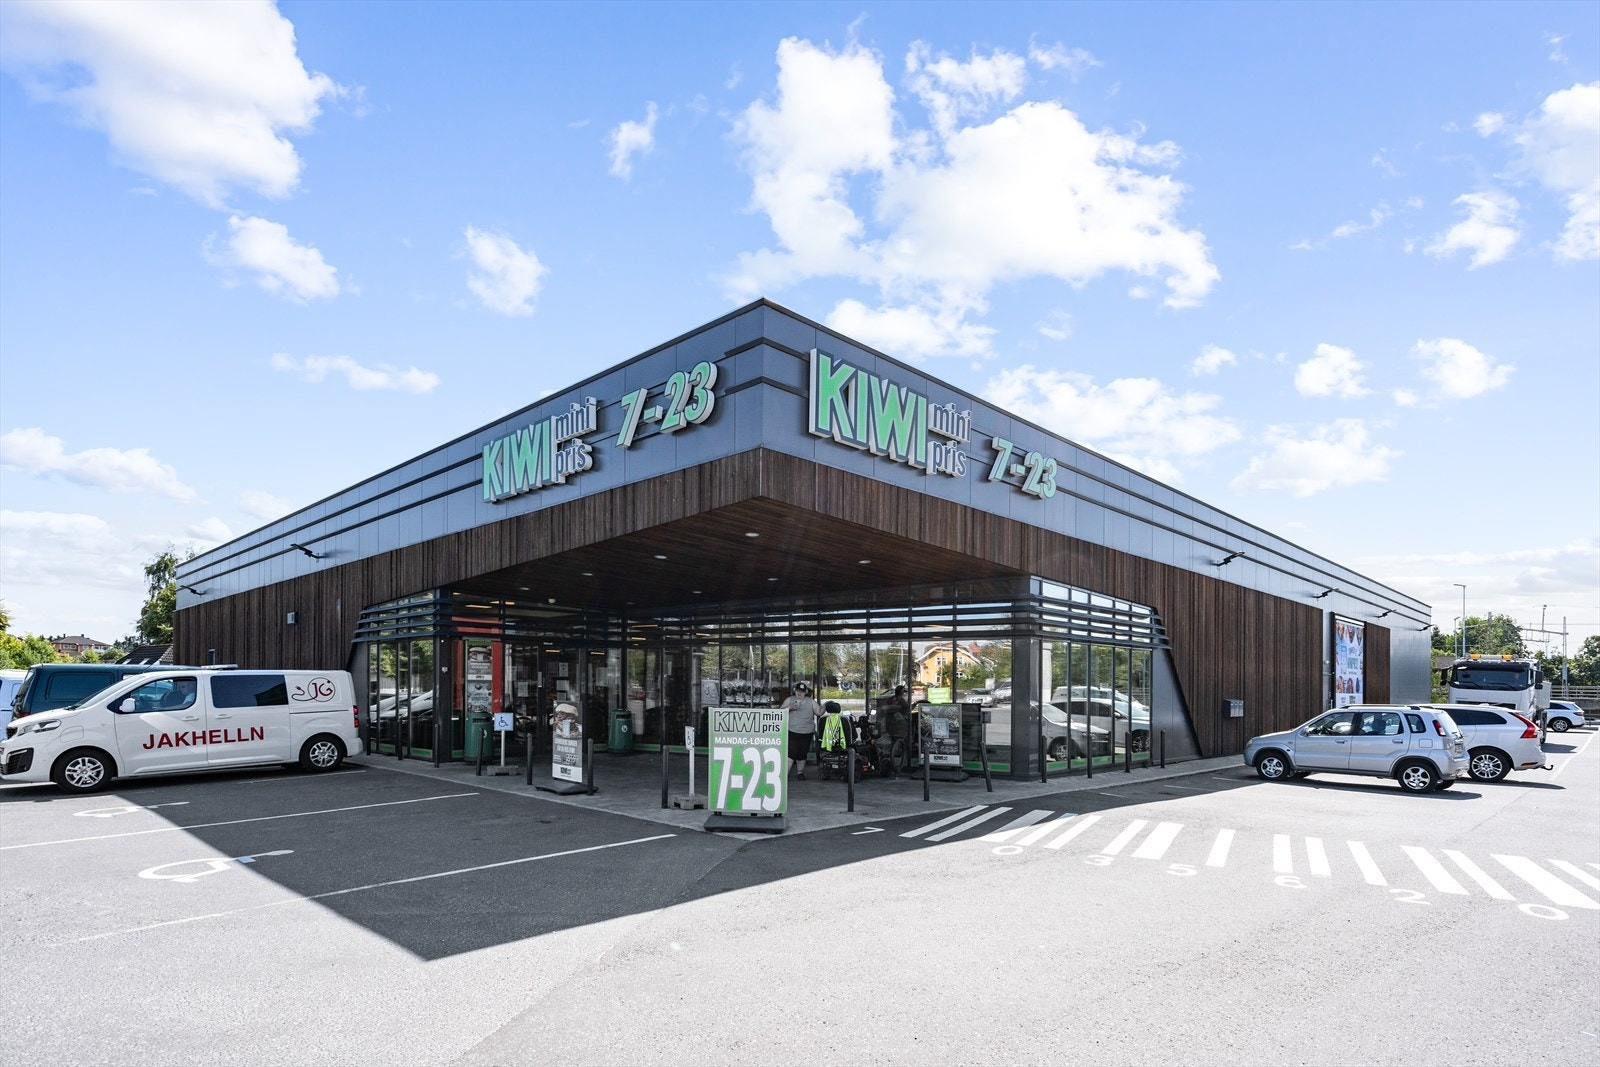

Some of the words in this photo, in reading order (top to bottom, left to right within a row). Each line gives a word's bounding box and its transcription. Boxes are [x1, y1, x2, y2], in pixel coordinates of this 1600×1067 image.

[554, 396, 597, 440] mini
[615, 361, 718, 448] 7-23
[808, 348, 929, 468] KIWI
[928, 402, 972, 442] mini
[482, 419, 552, 502] KIWI
[554, 438, 593, 483] pris
[926, 440, 967, 477] pris
[988, 436, 1057, 499] 7-23
[714, 711, 760, 732] KIWI
[762, 711, 783, 721] mini
[762, 722, 781, 733] pris
[143, 727, 265, 749] JAKHELLN
[714, 737, 782, 745] MANDAG-LØRDAG
[713, 747, 782, 811] 7-23
[1085, 855, 1115, 867] 3
[1165, 863, 1198, 876] 5
[1274, 875, 1308, 889] 6
